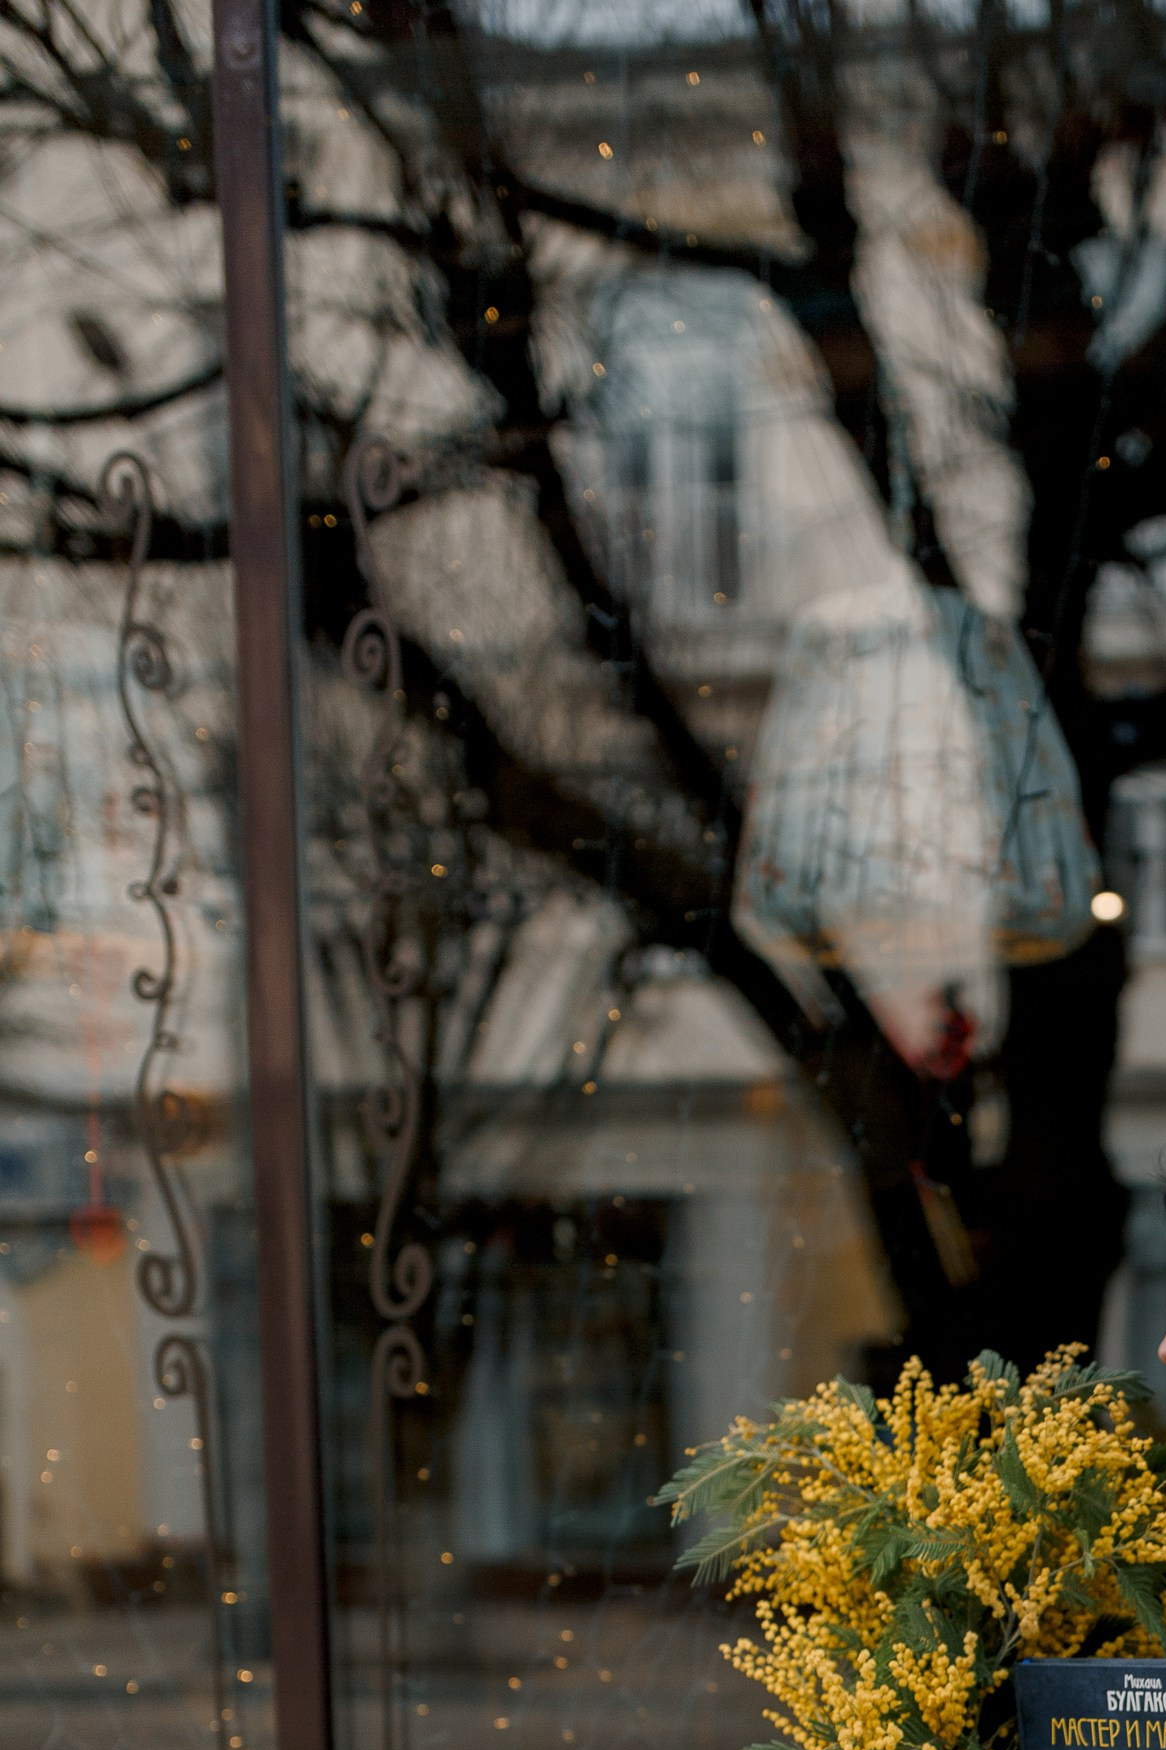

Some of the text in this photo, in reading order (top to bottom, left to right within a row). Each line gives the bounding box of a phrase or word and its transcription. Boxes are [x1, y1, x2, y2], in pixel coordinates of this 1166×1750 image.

[1123, 1674, 1163, 1690] Михаил
[1051, 1717, 1121, 1748] МАСТЕР
[1126, 1719, 1141, 1748] И
